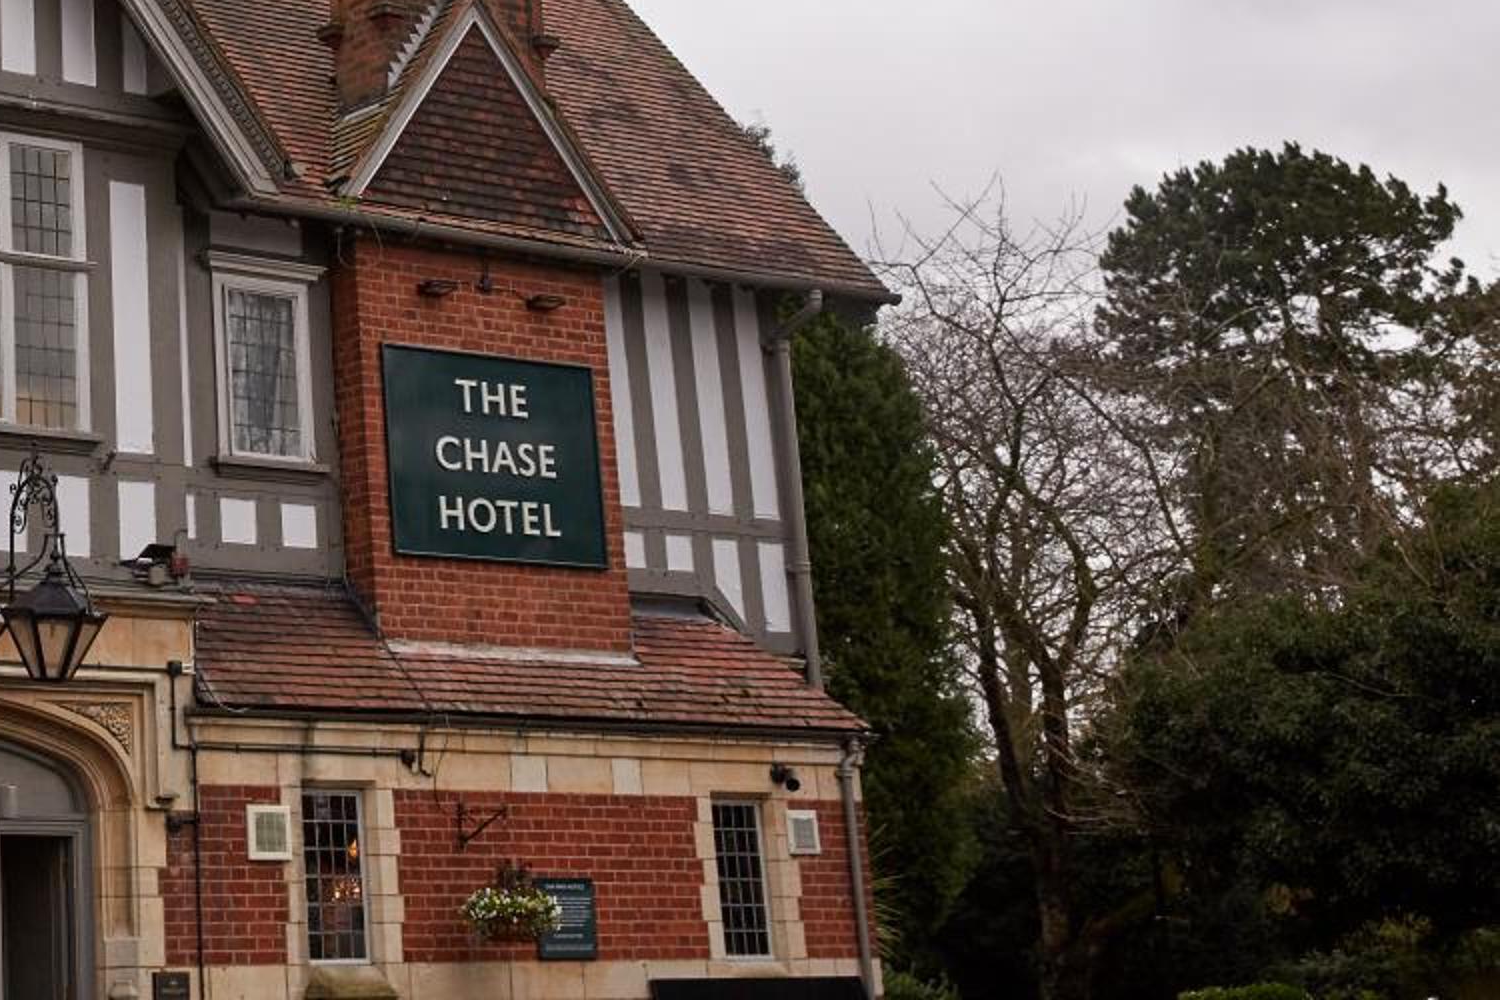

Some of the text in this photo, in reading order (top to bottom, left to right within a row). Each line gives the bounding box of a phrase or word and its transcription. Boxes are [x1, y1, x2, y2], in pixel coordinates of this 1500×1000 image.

[454, 378, 529, 419] THE
[435, 435, 557, 479] CHASE
[438, 495, 562, 537] HOTEL
